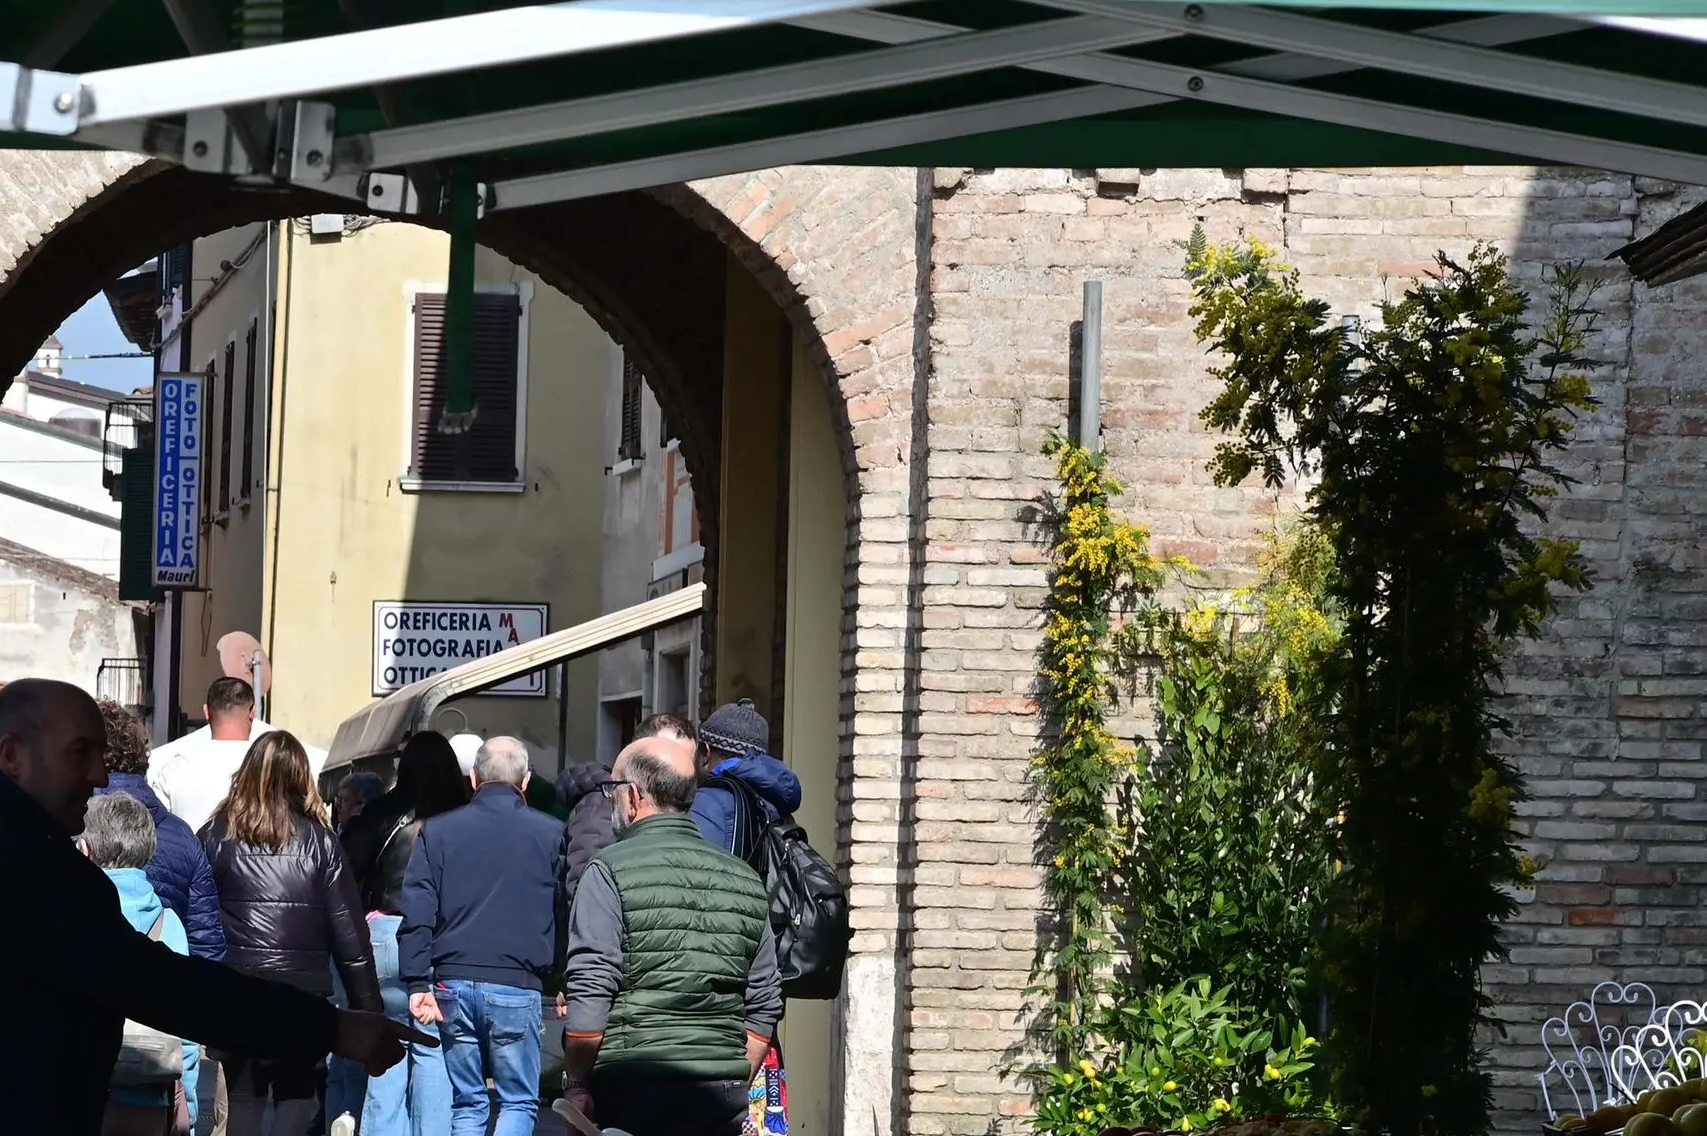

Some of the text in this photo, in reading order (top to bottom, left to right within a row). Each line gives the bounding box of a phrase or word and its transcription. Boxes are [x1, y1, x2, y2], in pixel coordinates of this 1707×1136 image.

[159, 383, 178, 565] OREFICERIA
[179, 383, 197, 569] FOTO OTTICA
[157, 569, 195, 584] Mauri
[384, 611, 492, 632] OREFICERIA
[383, 638, 503, 658] FOTOGRAFIA
[384, 666, 448, 685] OTTIC
